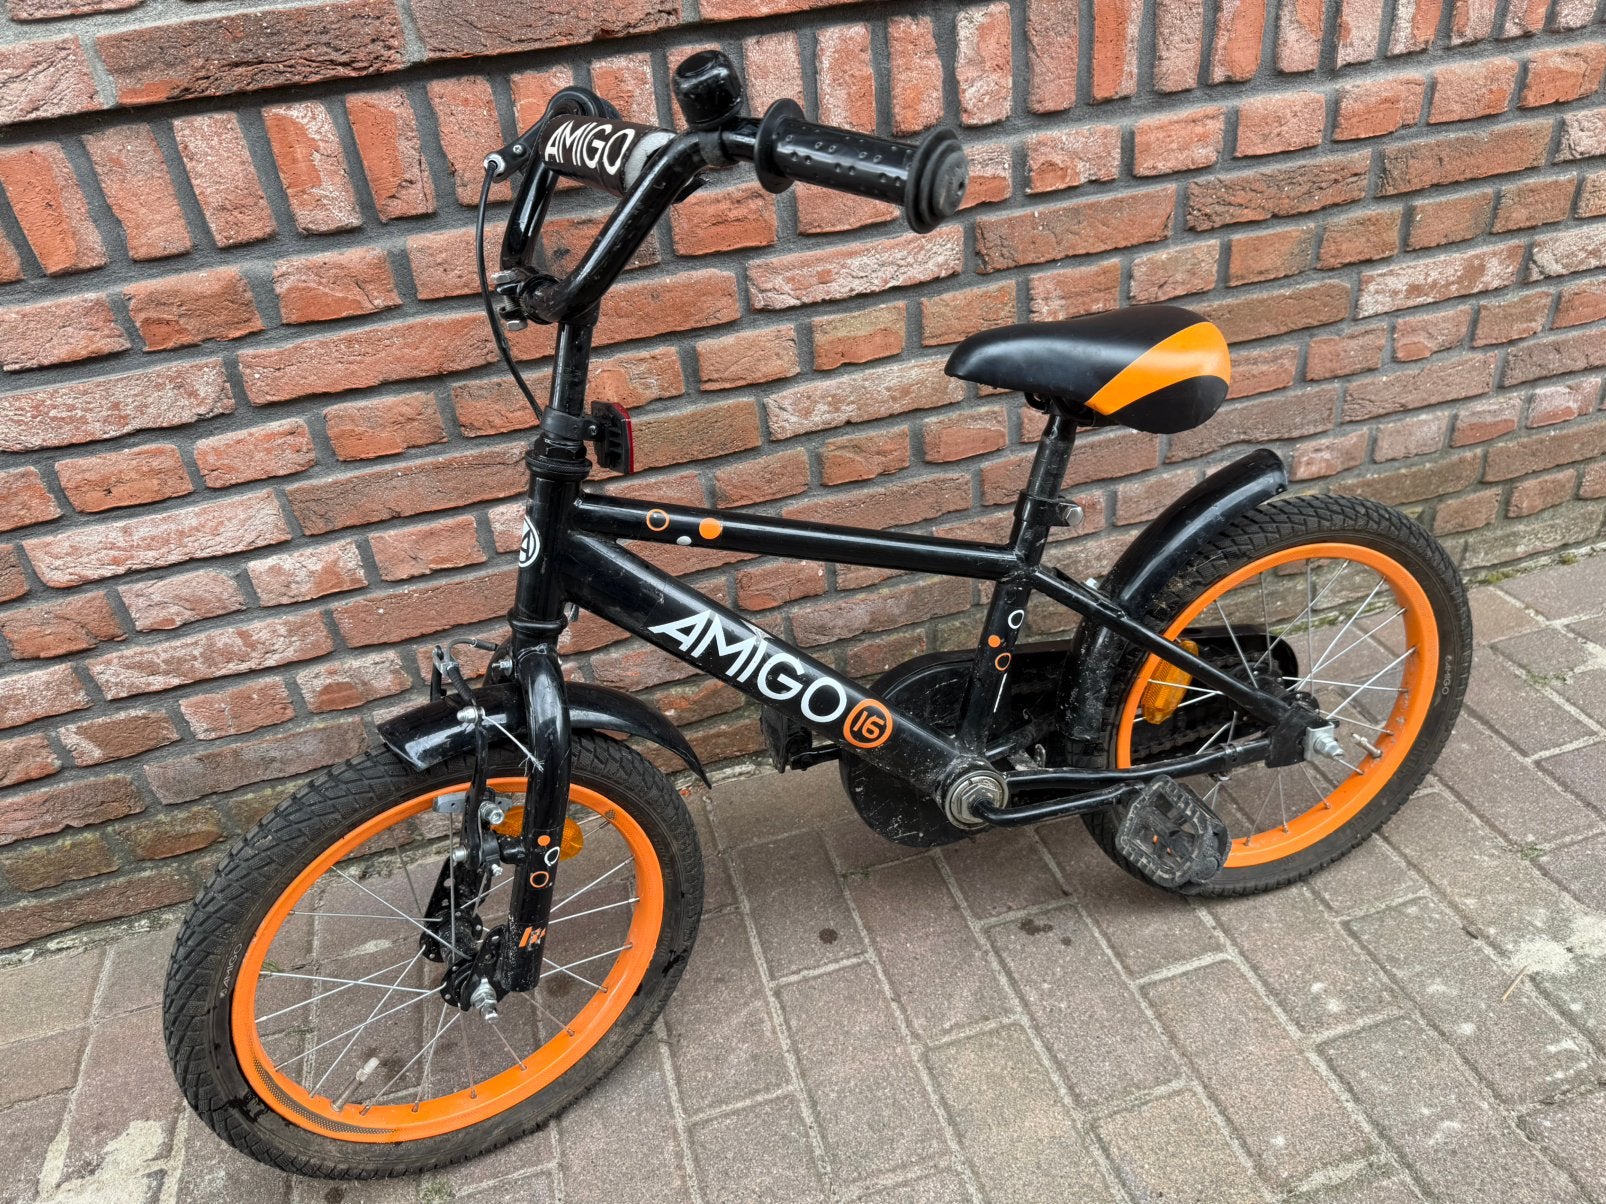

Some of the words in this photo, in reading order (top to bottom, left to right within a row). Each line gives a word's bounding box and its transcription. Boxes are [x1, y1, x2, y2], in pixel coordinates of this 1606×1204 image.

[544, 120, 636, 175] AMIGO
[648, 609, 847, 723] AMIGO
[852, 711, 886, 739] 16
[1441, 660, 1452, 695] AMIGO
[223, 943, 243, 988] AMIGO
